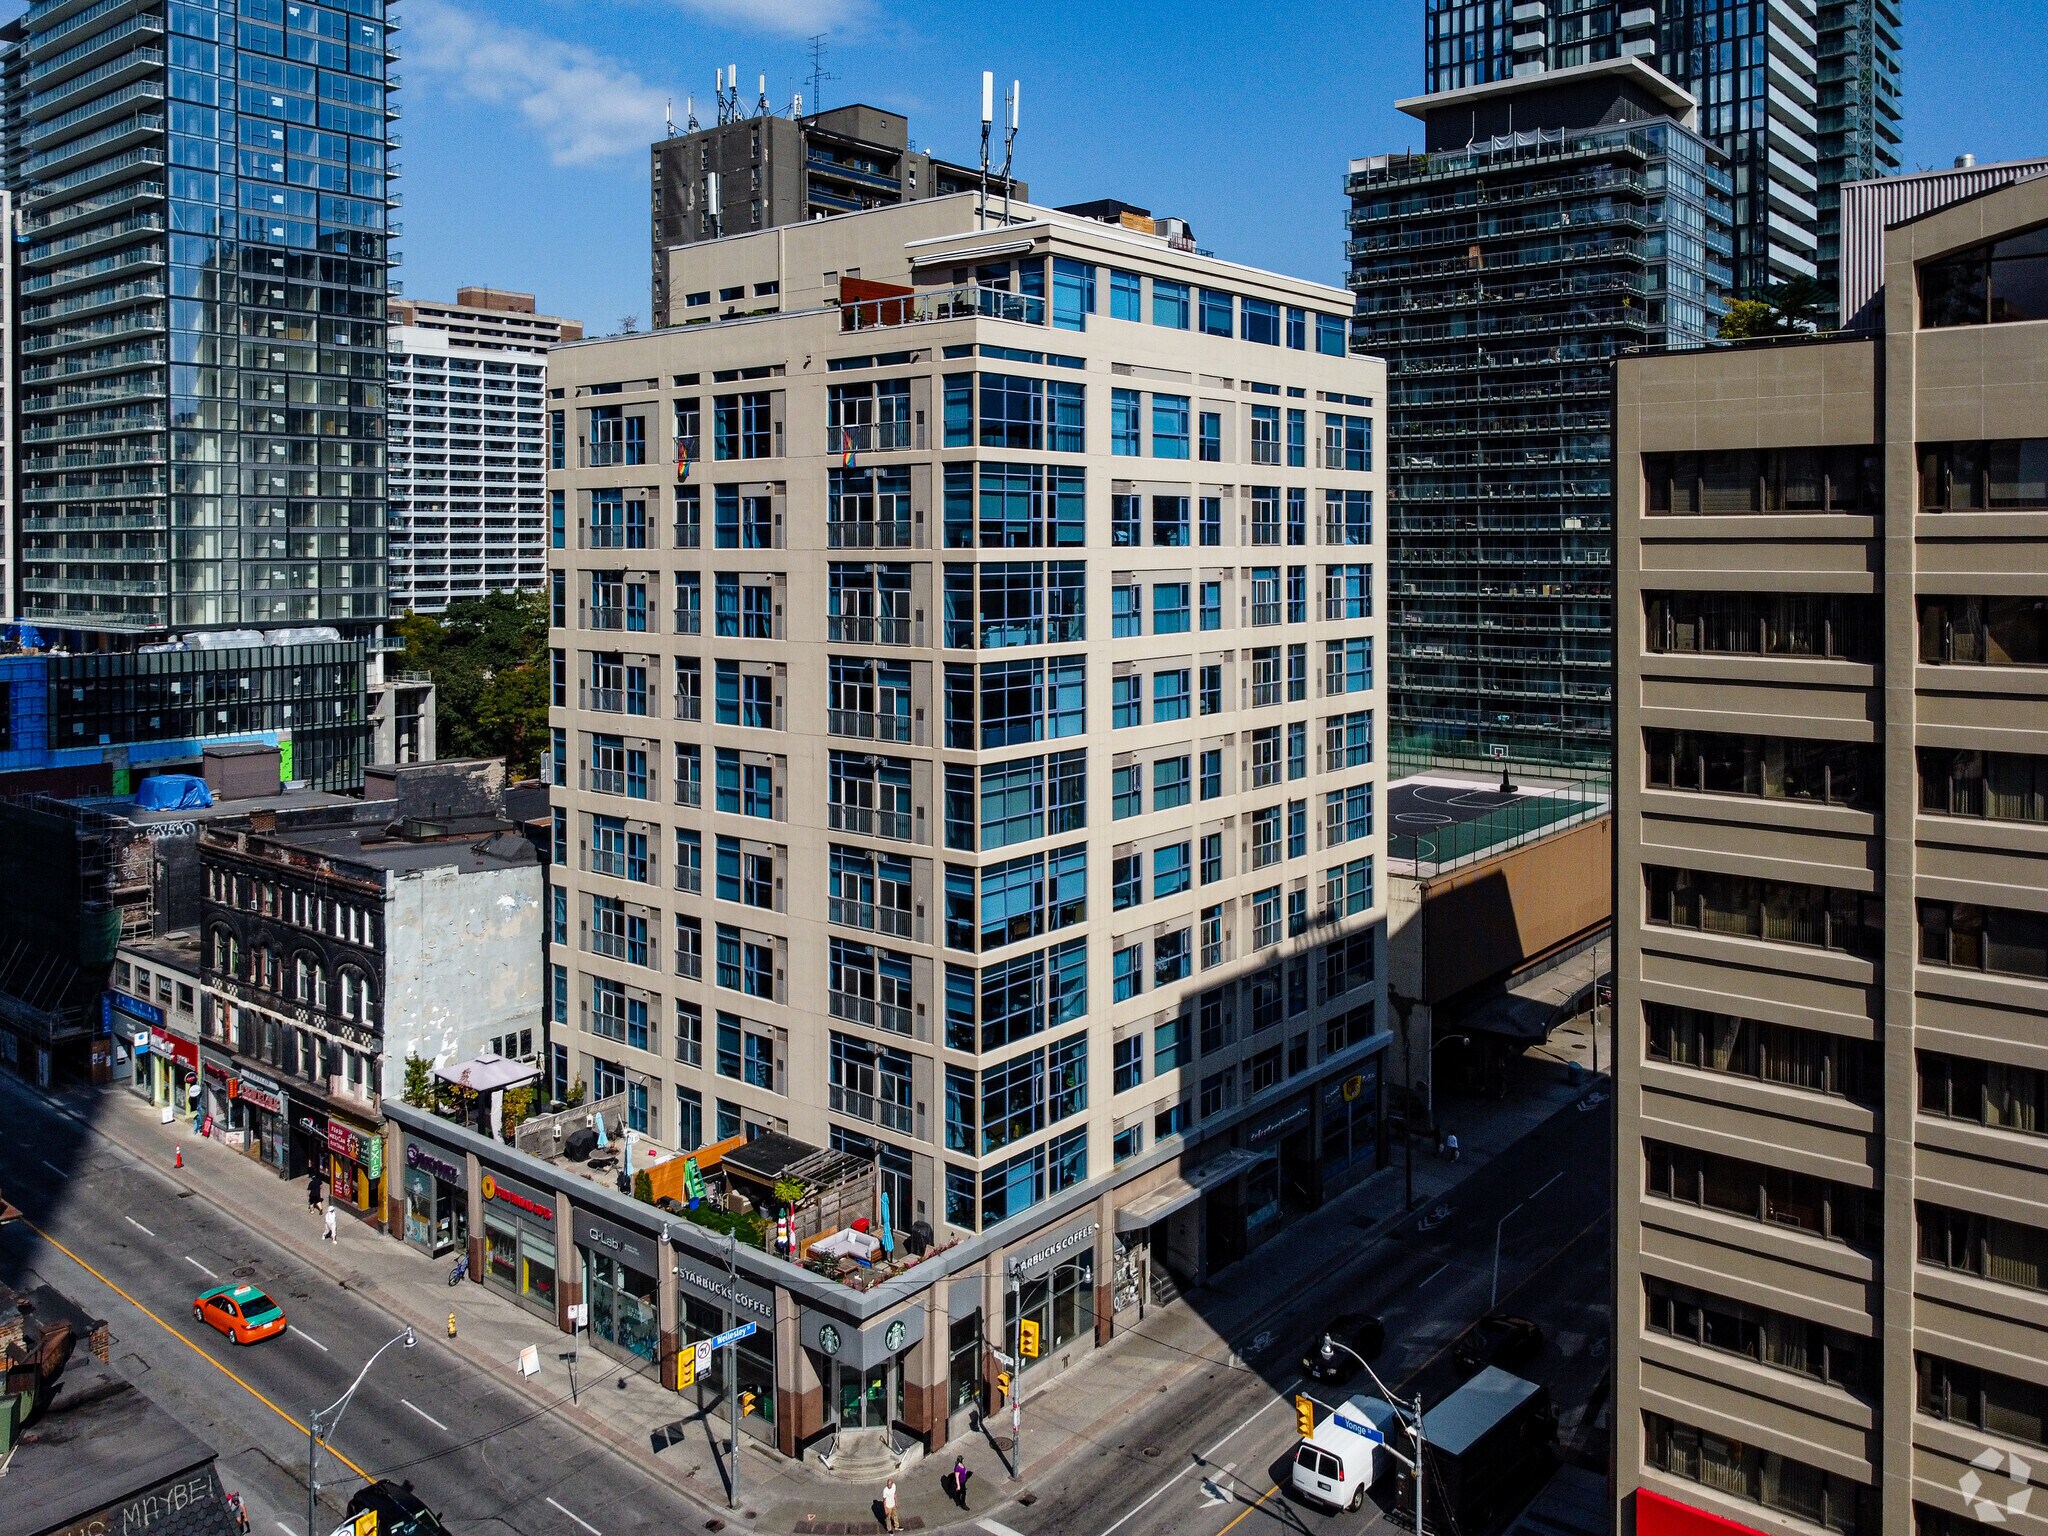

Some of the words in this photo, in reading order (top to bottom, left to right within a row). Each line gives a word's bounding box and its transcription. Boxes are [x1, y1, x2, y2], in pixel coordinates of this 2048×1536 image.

[371, 1138, 380, 1177] MEXICO
[1020, 1242, 1061, 1271] ARBUCKS
[1061, 1225, 1093, 1248] COFFEE
[679, 1268, 732, 1299] STARBUCKS
[735, 1292, 772, 1317] COFFEE
[717, 1327, 747, 1344] Wellesley
[1344, 1419, 1367, 1435] Yonge
[123, 1474, 215, 1536] MAYBE!
